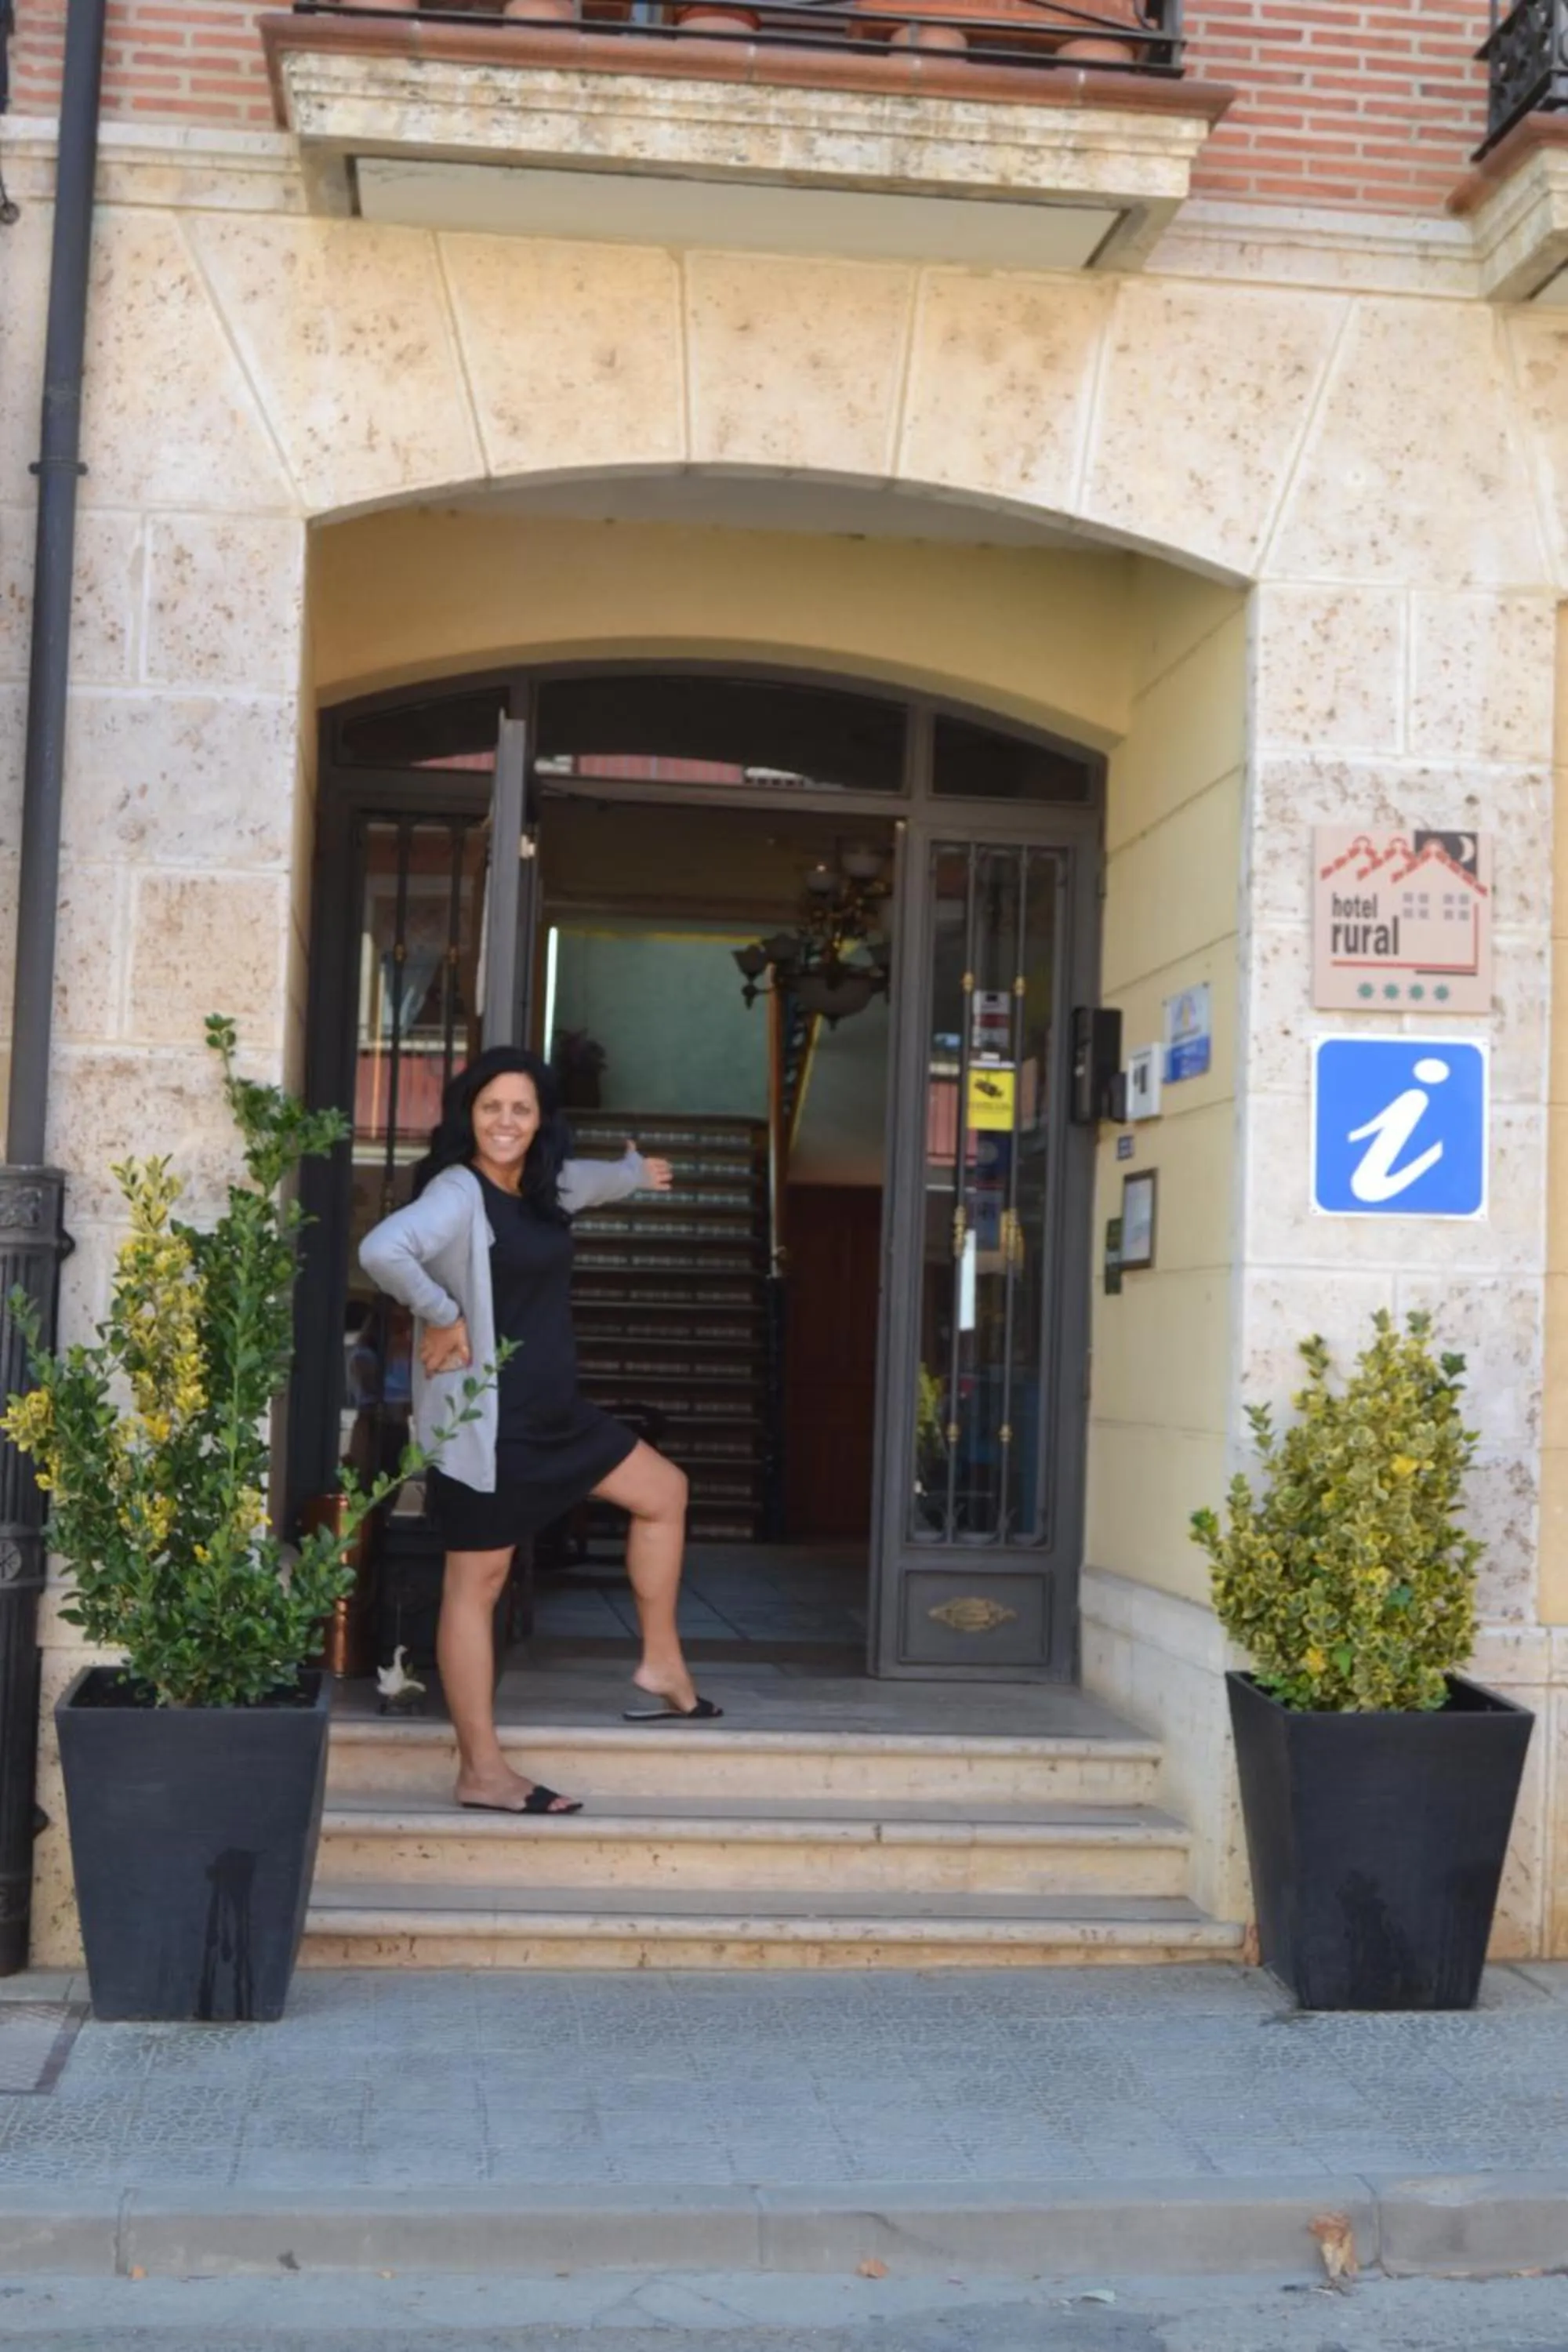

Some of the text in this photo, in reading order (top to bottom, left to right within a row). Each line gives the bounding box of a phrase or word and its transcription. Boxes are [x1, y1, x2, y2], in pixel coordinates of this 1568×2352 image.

[1332, 891, 1378, 919] hotel
[1331, 915, 1399, 956] rural
[1348, 1058, 1450, 1202] i
